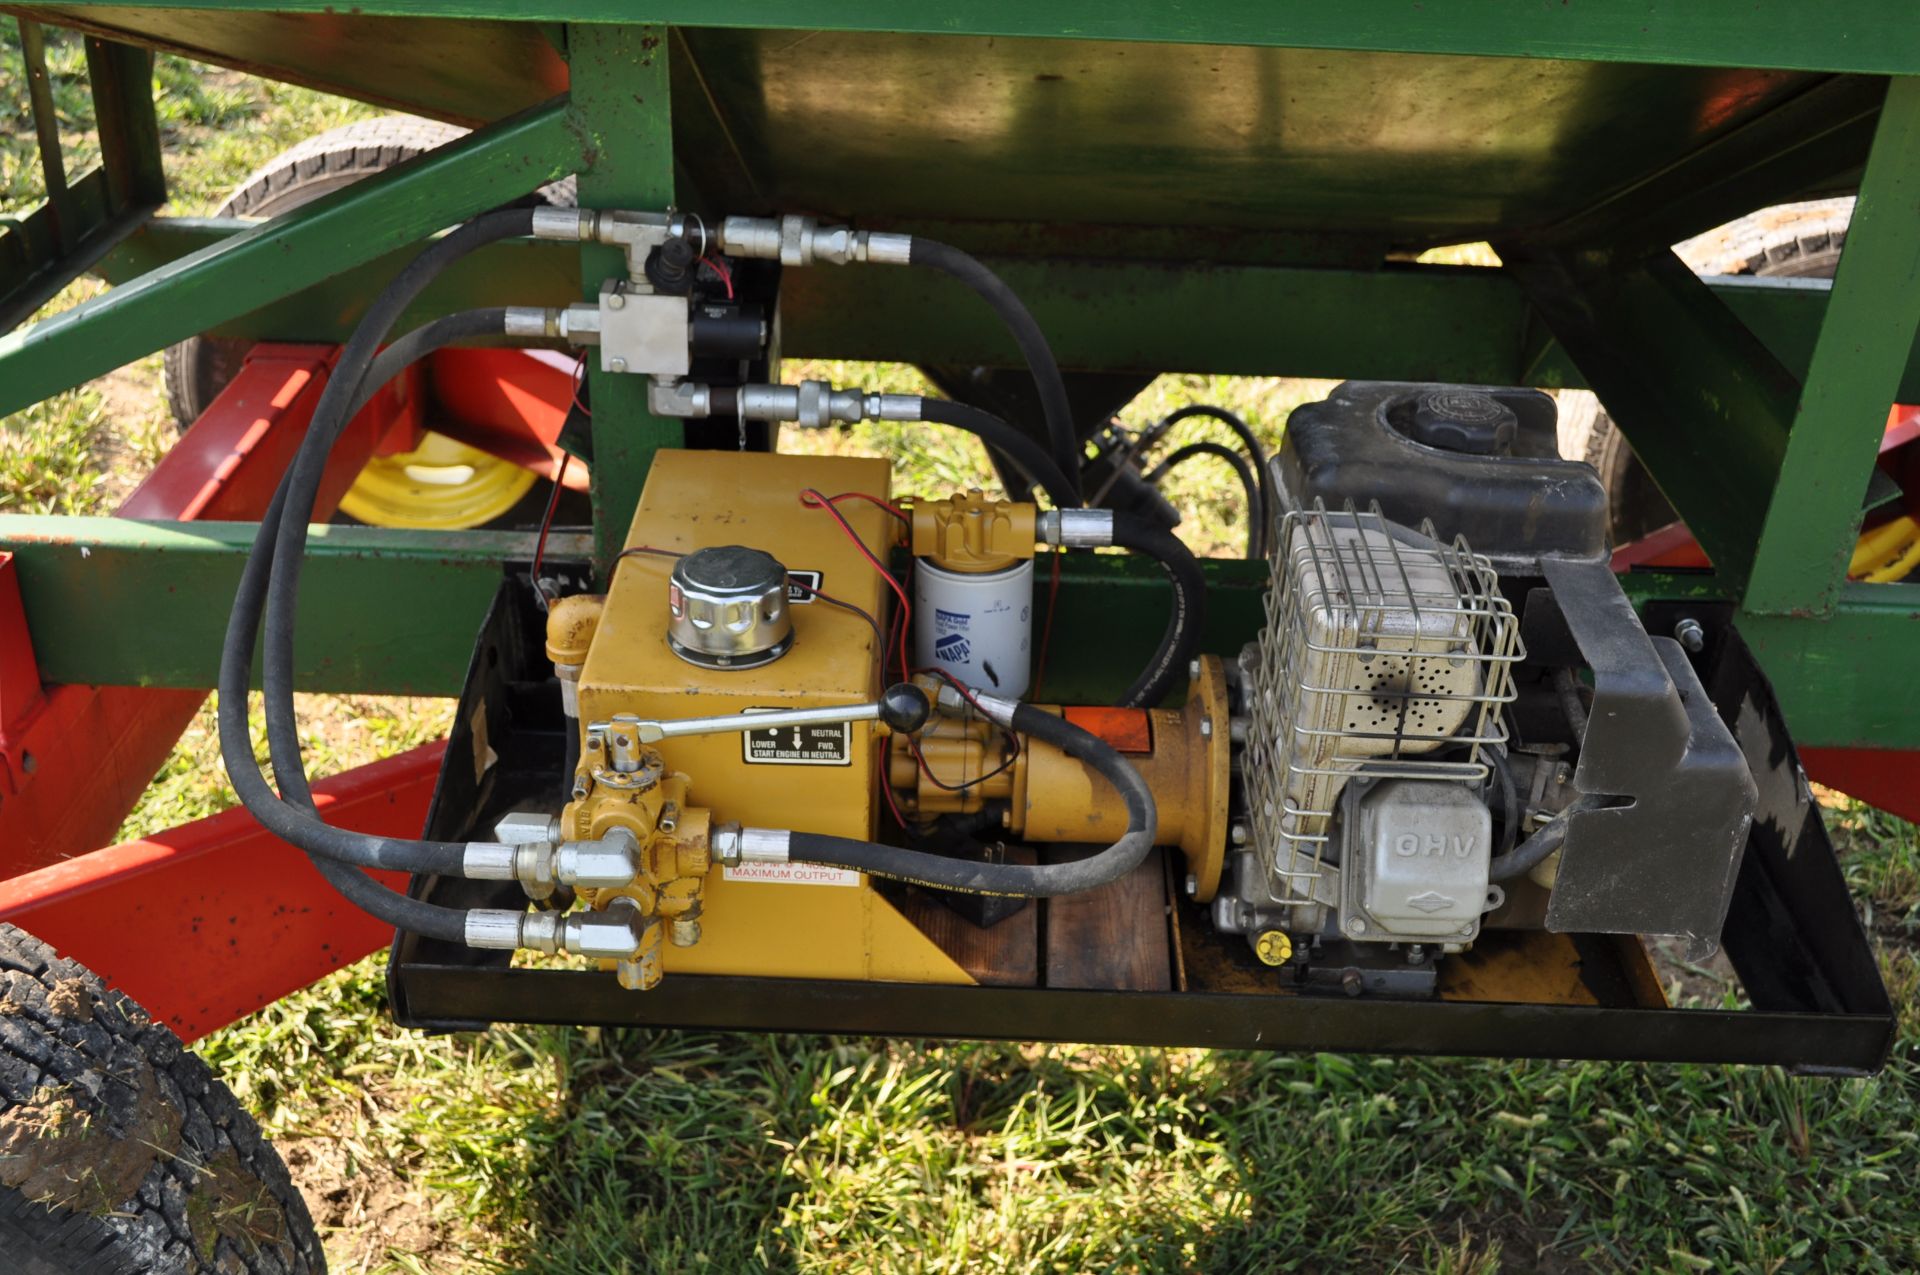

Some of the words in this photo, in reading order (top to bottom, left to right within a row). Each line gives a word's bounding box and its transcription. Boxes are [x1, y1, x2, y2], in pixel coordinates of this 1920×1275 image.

[940, 642, 970, 662] NAPA
[811, 730, 842, 738] NEUTRAL
[752, 741, 776, 749] LOWER
[817, 742, 836, 750] FWD.
[753, 749, 774, 758] START
[775, 751, 801, 759] ENGINE
[801, 751, 810, 759] IN
[811, 752, 841, 760] NEUTRAL
[1396, 832, 1475, 858] OHV
[732, 867, 791, 879] MAXIMUM
[793, 870, 844, 881] OUTPUT
